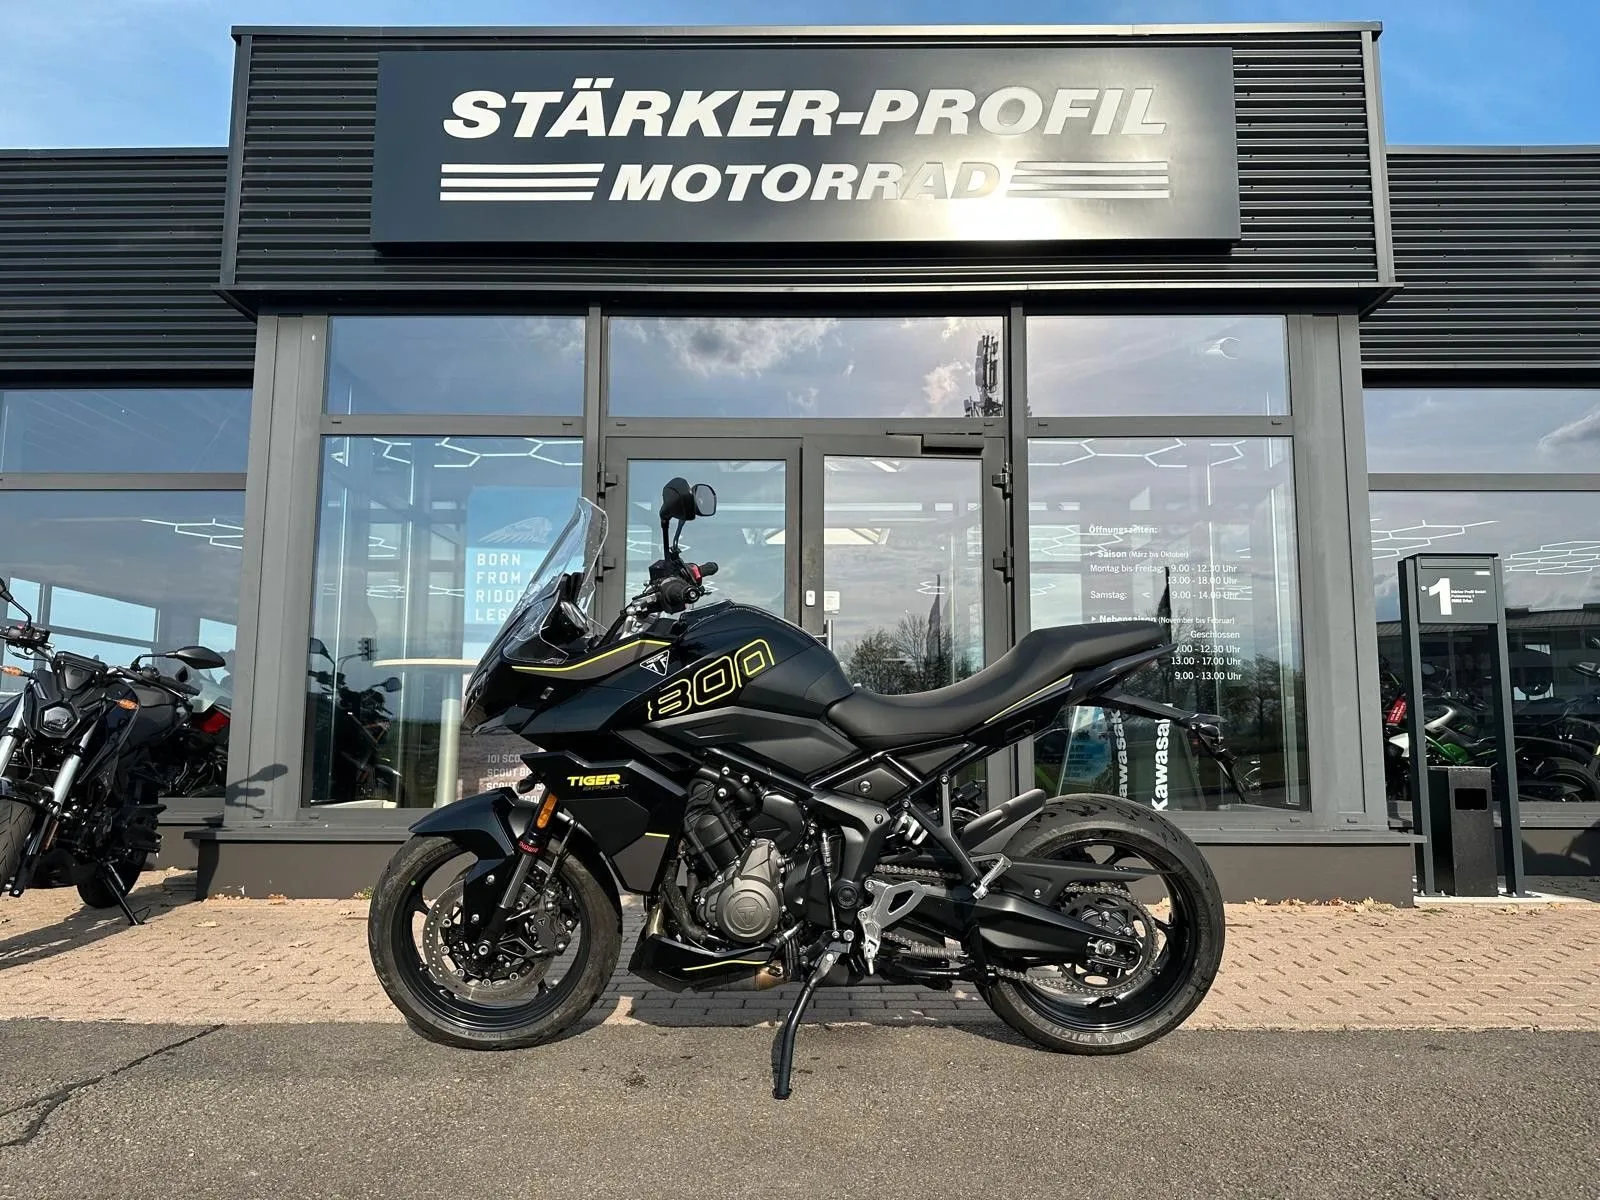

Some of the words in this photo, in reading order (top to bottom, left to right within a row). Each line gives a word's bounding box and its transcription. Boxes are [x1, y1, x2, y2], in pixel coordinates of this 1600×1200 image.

[443, 77, 1167, 139] STÄRKER-PROFIL
[608, 162, 1001, 203] MOTORRAD
[477, 553, 521, 567] BORN
[1098, 549, 1127, 558] Saison
[1149, 550, 1159, 558] bis
[1161, 550, 1189, 559] Oktober)
[1090, 564, 1120, 574] Montag
[1122, 564, 1133, 573] bis
[1171, 564, 1190, 573] 9.00
[1222, 564, 1238, 573] Uhr
[476, 571, 521, 585] FROM
[1167, 576, 1191, 585] 13.00
[1223, 576, 1238, 585] Uhr
[476, 589, 524, 603] RIDD
[1090, 590, 1129, 601] Samstag:
[1171, 590, 1191, 600] 9.00
[1223, 590, 1239, 600] Uhr
[1429, 577, 1452, 615] 1
[475, 608, 507, 622] LEG
[1195, 616, 1206, 624] bis
[1200, 644, 1224, 653] 12.30
[1225, 644, 1241, 653] Uhr
[1171, 656, 1195, 666] 13.00
[1202, 656, 1225, 666] 17.00
[1226, 656, 1242, 666] Uhr
[647, 638, 776, 721] 800
[1174, 671, 1194, 680] 9.00
[1201, 671, 1225, 680] 13.00
[1226, 671, 1242, 680] Uhr
[502, 754, 521, 764] SCO
[1110, 709, 1129, 799] awasak
[487, 768, 517, 777] SCOUT
[566, 773, 621, 787] TIGER
